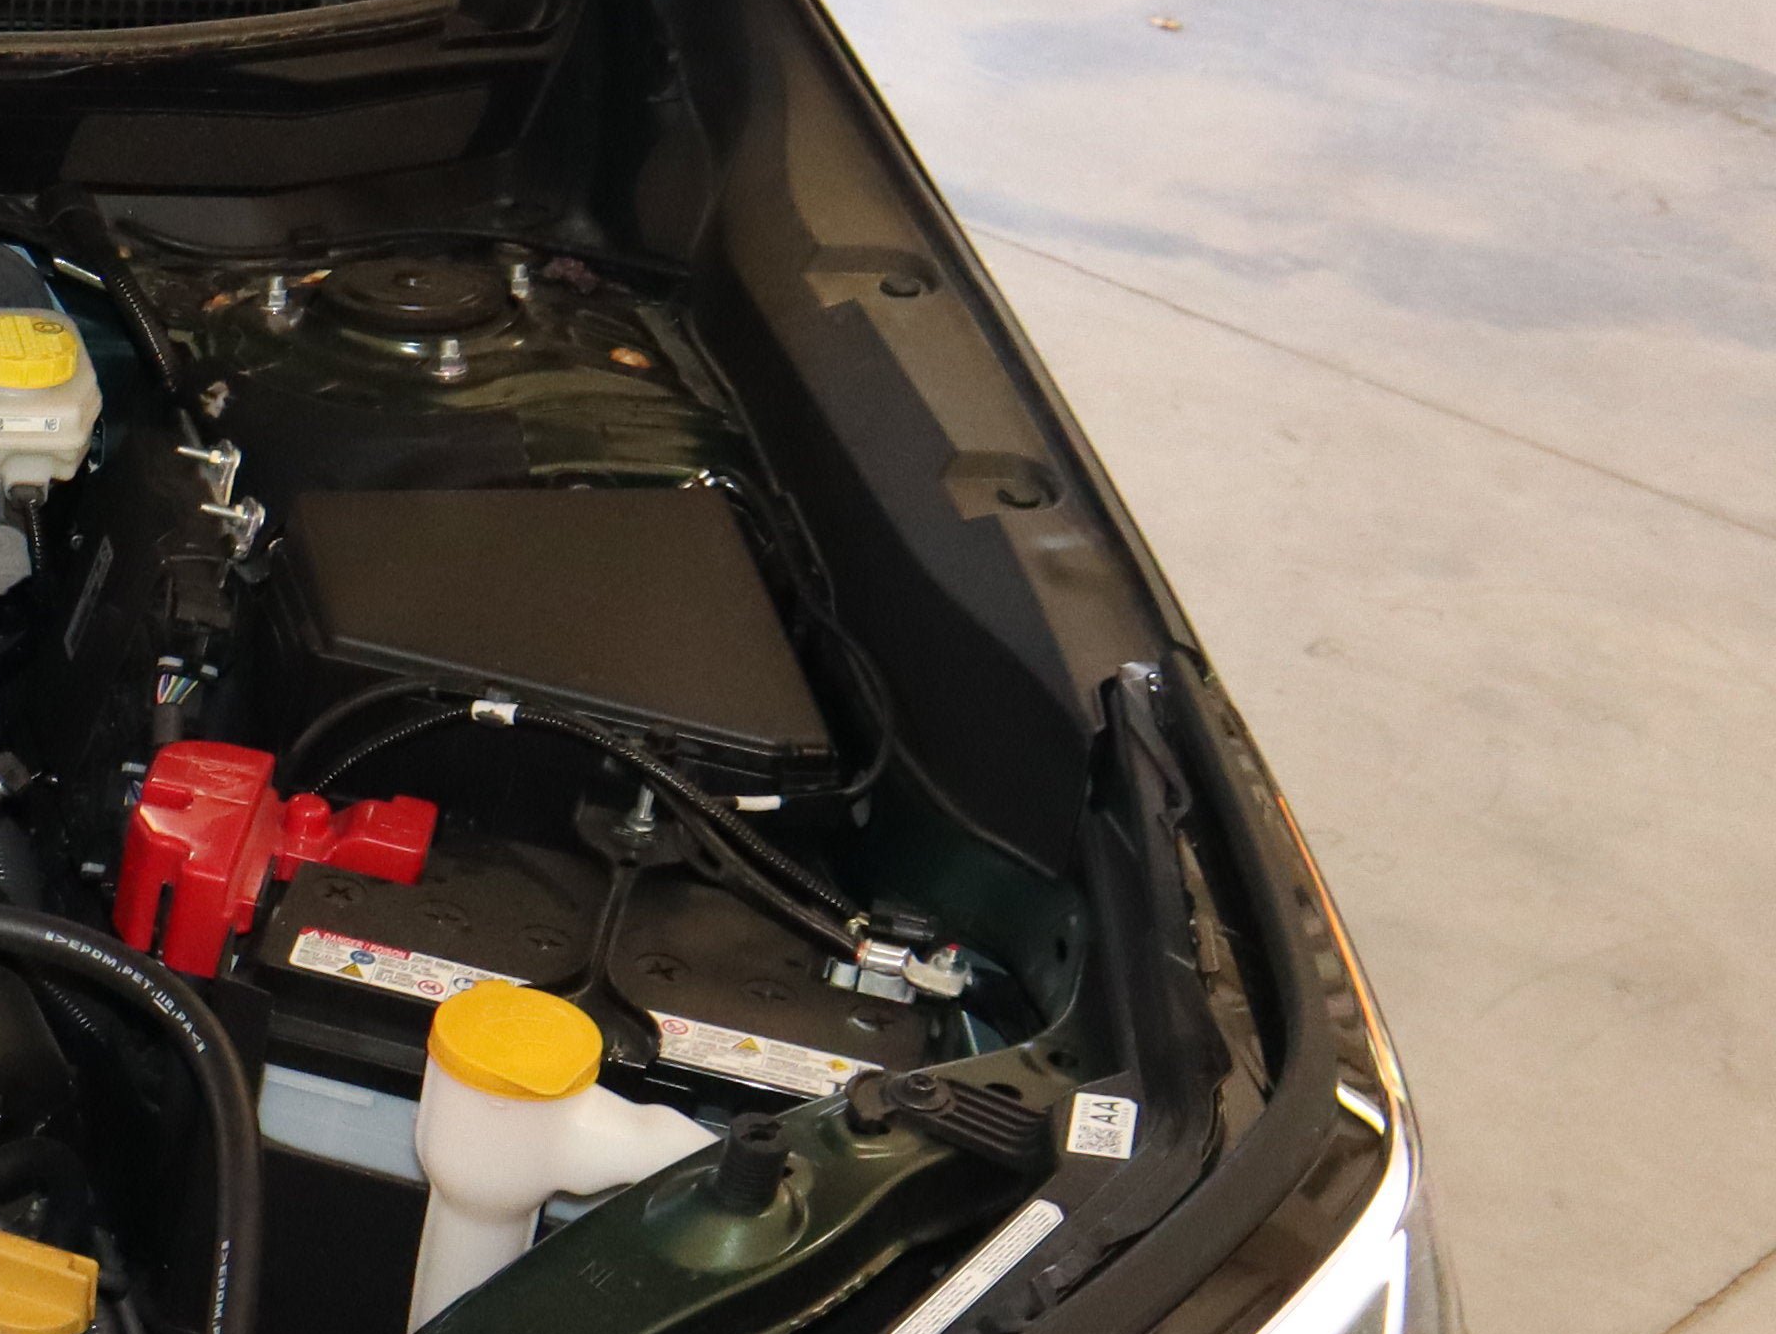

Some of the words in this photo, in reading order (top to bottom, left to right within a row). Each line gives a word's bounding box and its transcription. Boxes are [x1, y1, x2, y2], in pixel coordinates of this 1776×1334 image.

[322, 932, 364, 949] DANGER
[369, 943, 407, 960] POISON
[1089, 1101, 1121, 1126] AA
